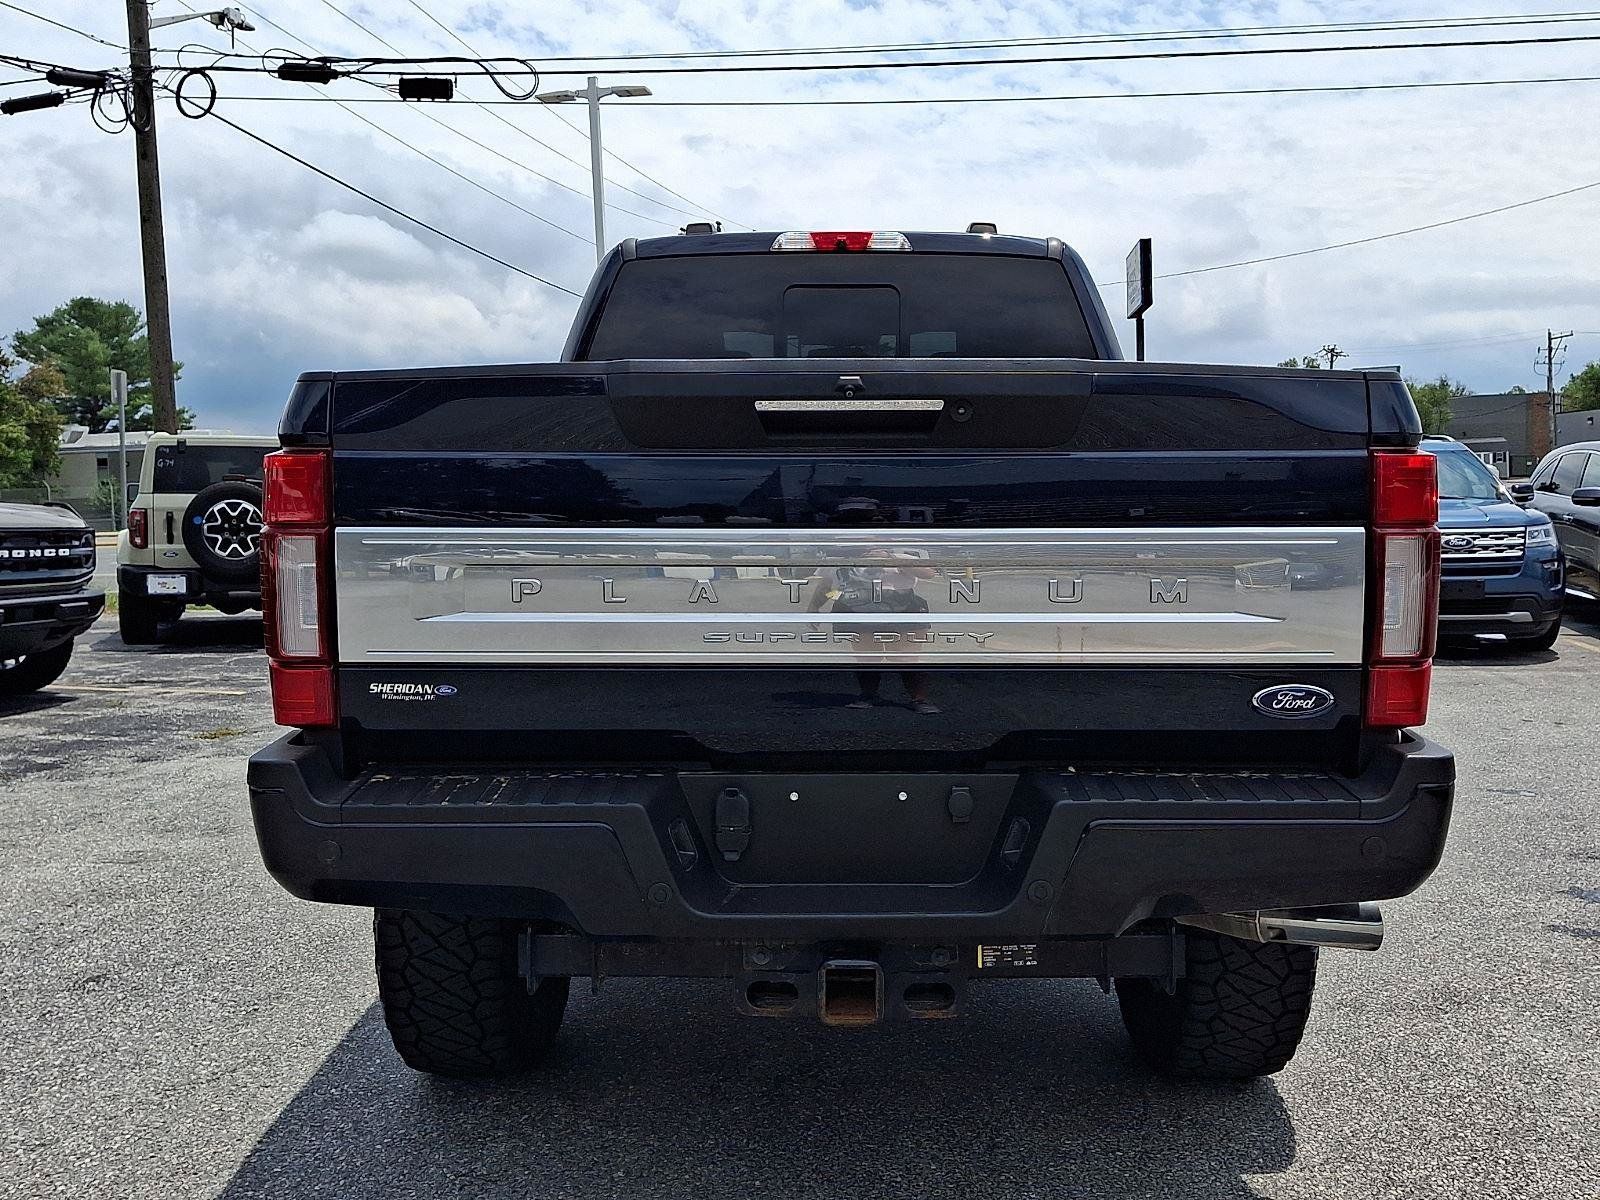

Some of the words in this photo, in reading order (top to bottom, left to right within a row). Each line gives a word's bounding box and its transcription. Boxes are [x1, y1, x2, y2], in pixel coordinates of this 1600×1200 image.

[511, 577, 1188, 604] PLATINUM
[703, 631, 861, 644] SUPER
[872, 631, 995, 644] DUTY
[369, 683, 434, 694] SHERIDAN
[1272, 691, 1317, 709] Ford
